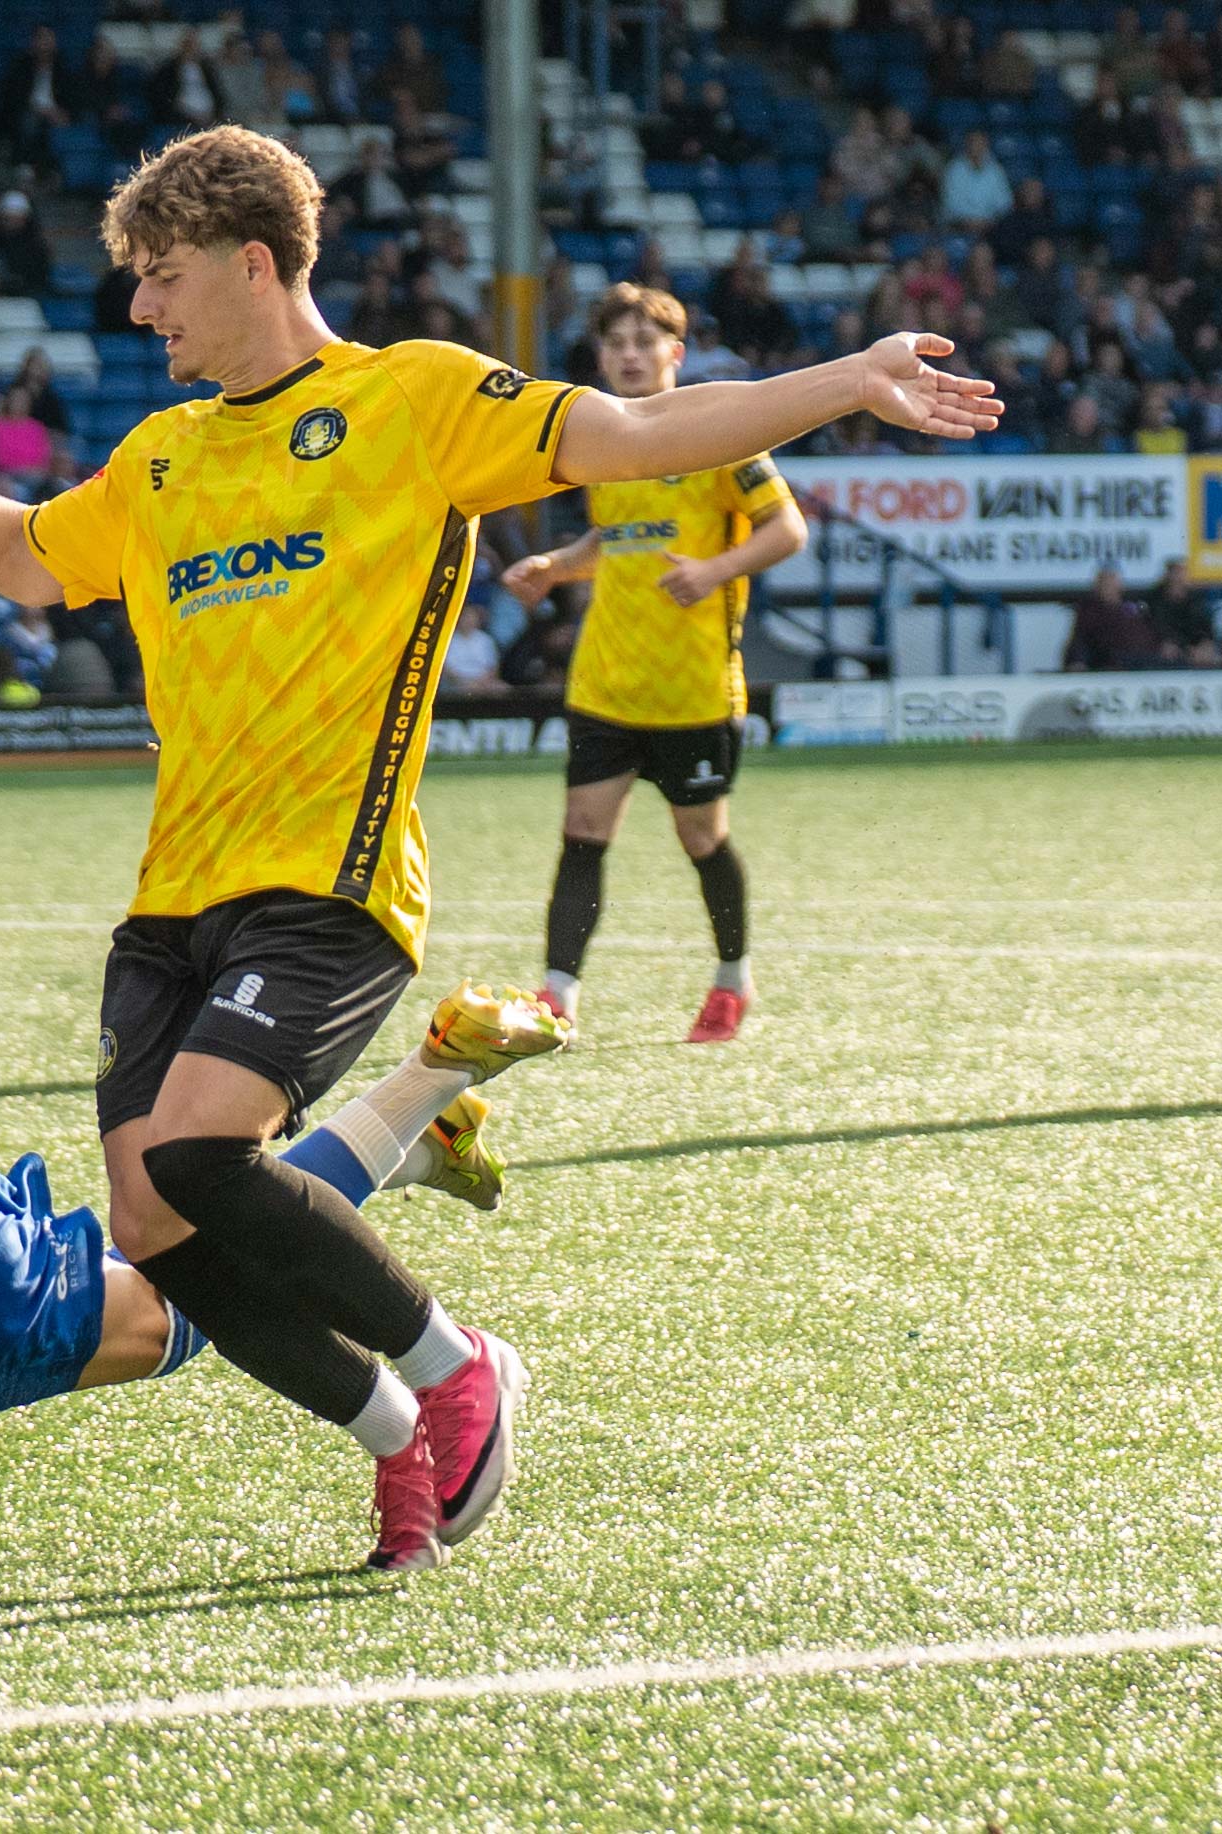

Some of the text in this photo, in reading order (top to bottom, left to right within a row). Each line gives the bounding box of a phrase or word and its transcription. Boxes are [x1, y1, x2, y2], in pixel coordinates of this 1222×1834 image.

[976, 475, 1063, 519] VAN
[1072, 475, 1172, 519] HIRE
[167, 531, 326, 606] BREXONS
[180, 579, 290, 620] WORKWEAR
[351, 565, 456, 882] GAINSBOROUGH TRINITY FC
[212, 996, 276, 1028] SURRIDGE
